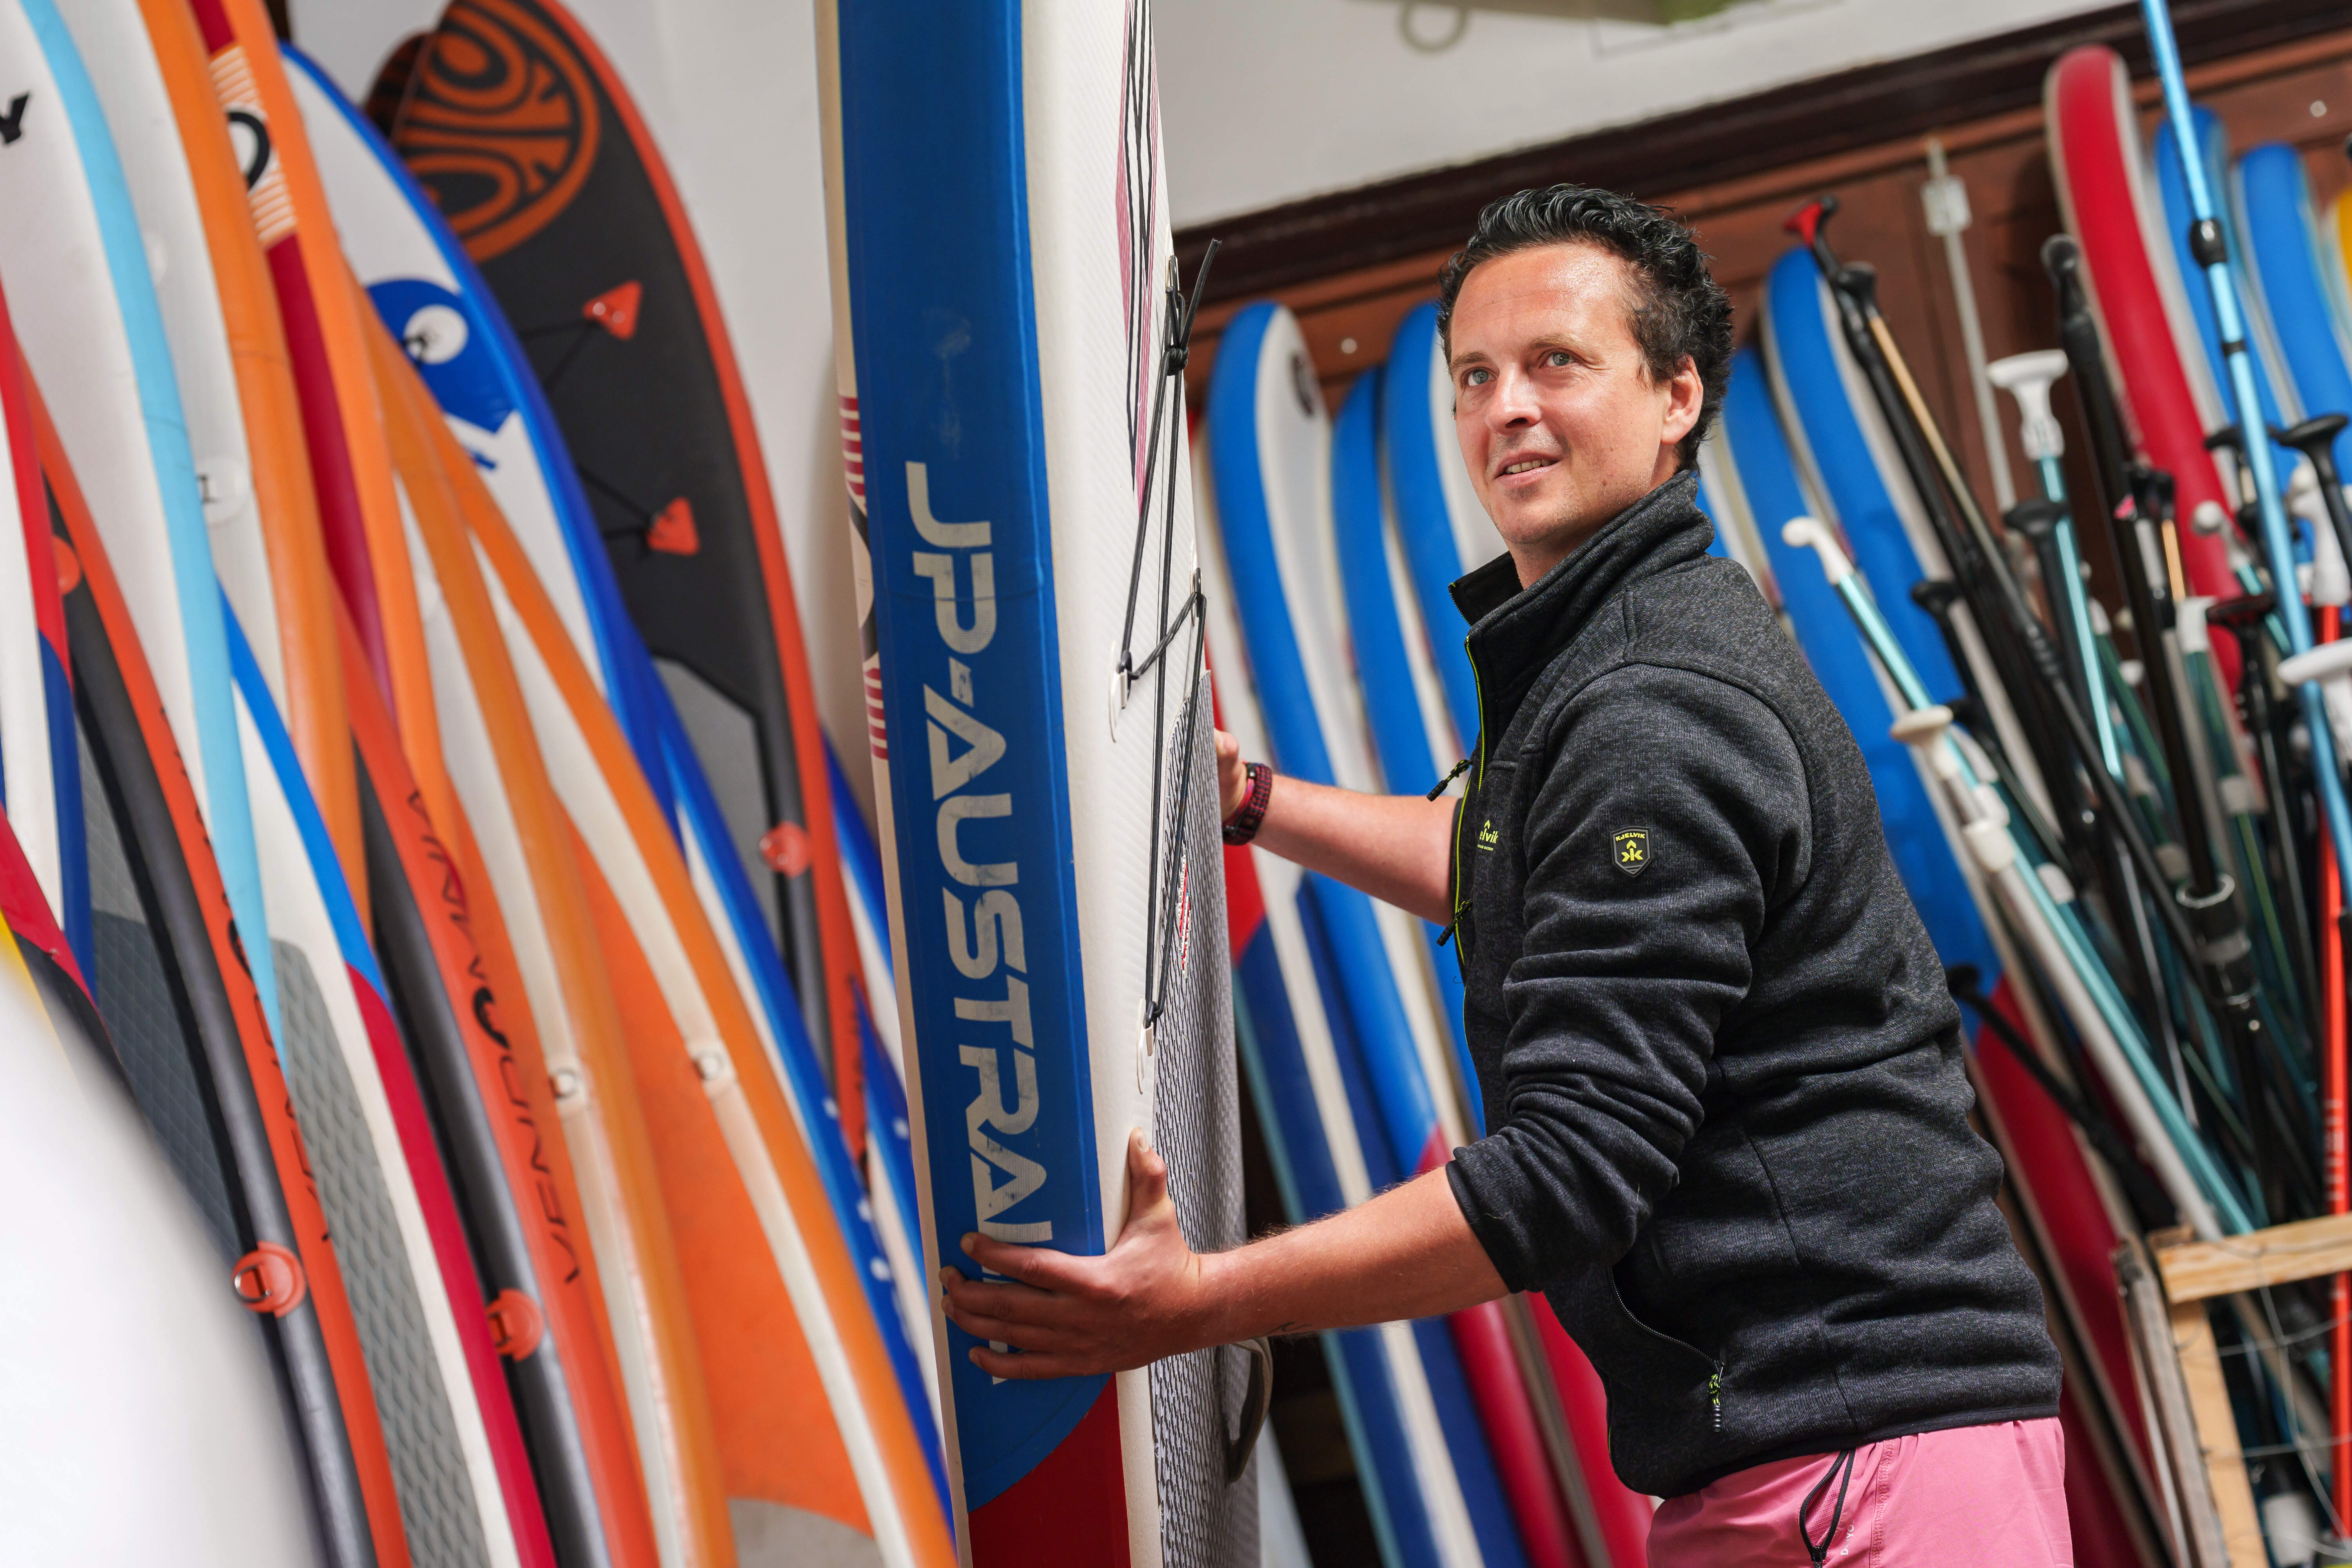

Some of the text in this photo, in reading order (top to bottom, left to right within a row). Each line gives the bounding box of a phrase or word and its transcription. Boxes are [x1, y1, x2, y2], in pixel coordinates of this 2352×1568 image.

[1615, 832, 1645, 842] KJELVIK
[906, 461, 1053, 1385] JP-AUSTRAL
[1841, 1519, 1855, 1555] DYO
